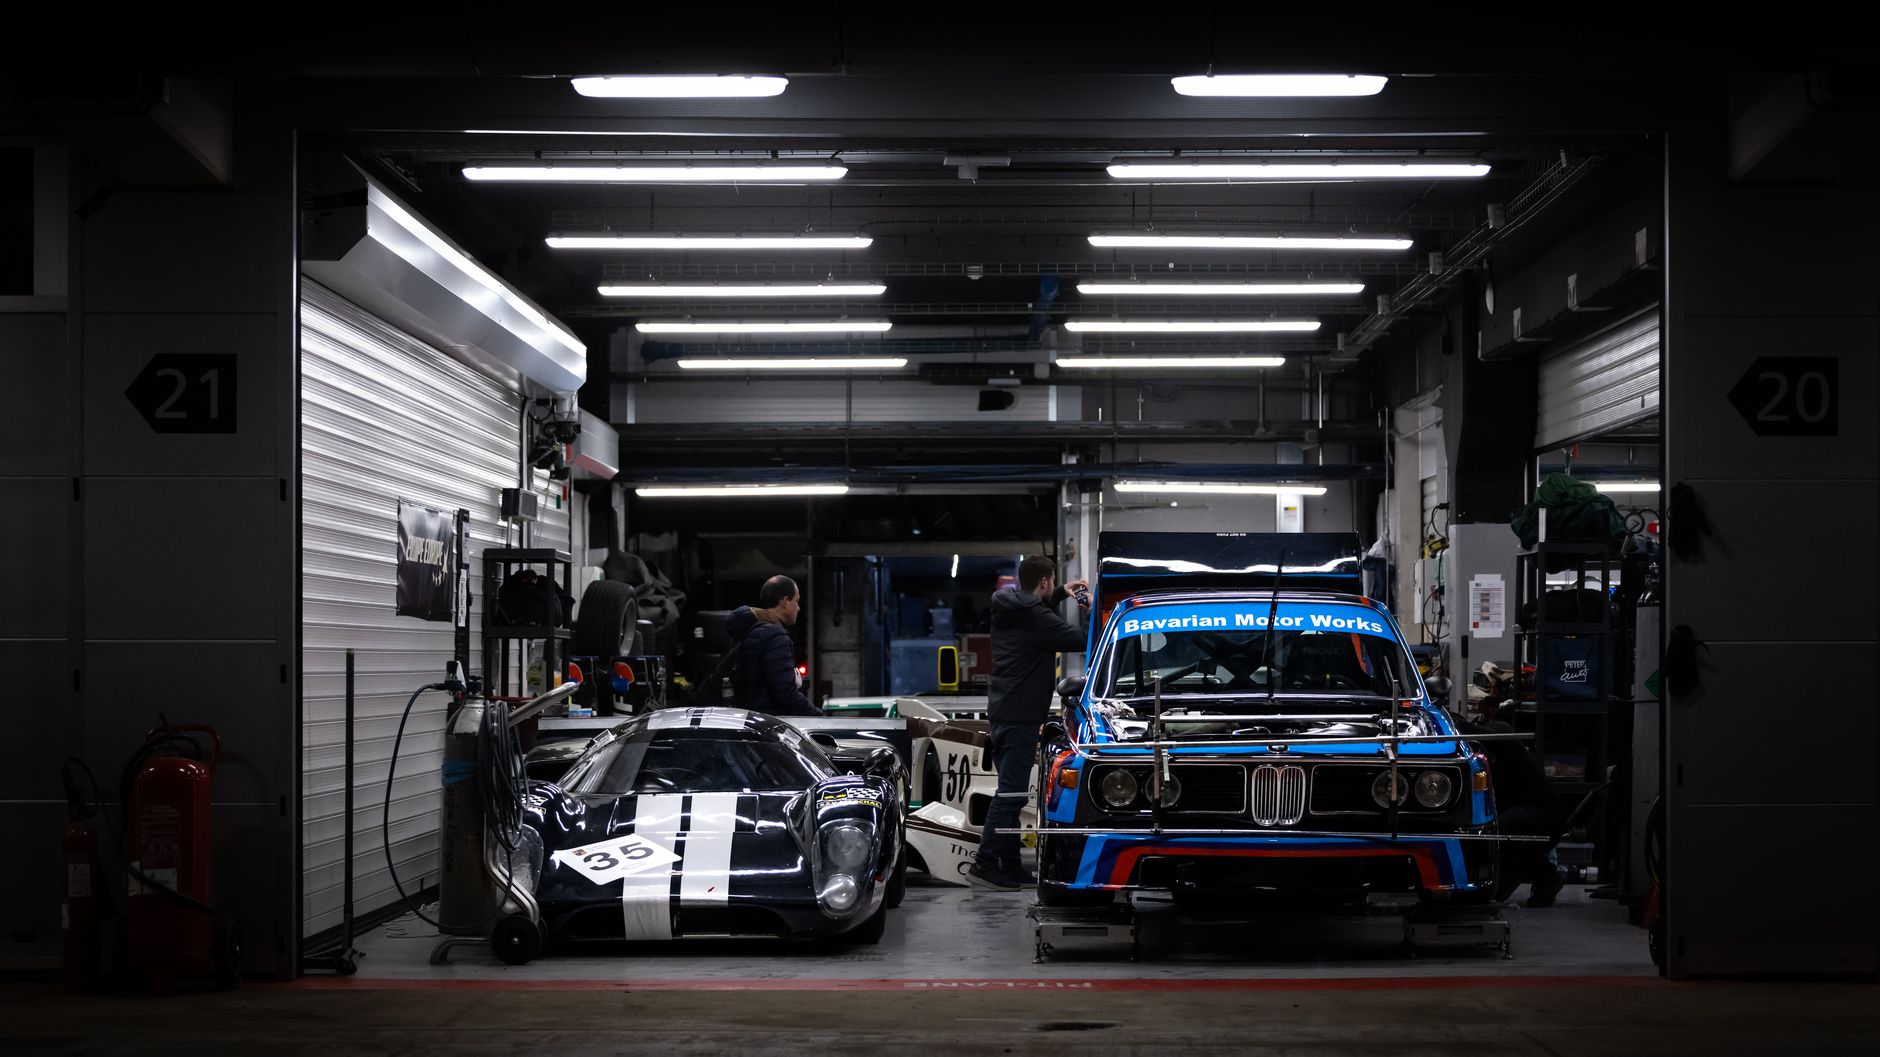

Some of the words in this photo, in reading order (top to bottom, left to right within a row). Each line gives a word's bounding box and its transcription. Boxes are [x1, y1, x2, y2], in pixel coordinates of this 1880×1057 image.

[154, 367, 220, 420] 21
[1757, 370, 1831, 422] 20
[1123, 616, 1227, 634] Bavarian
[1234, 613, 1304, 627] Motor
[1309, 614, 1383, 633] Works
[946, 752, 971, 804] 50
[583, 841, 655, 871] 35
